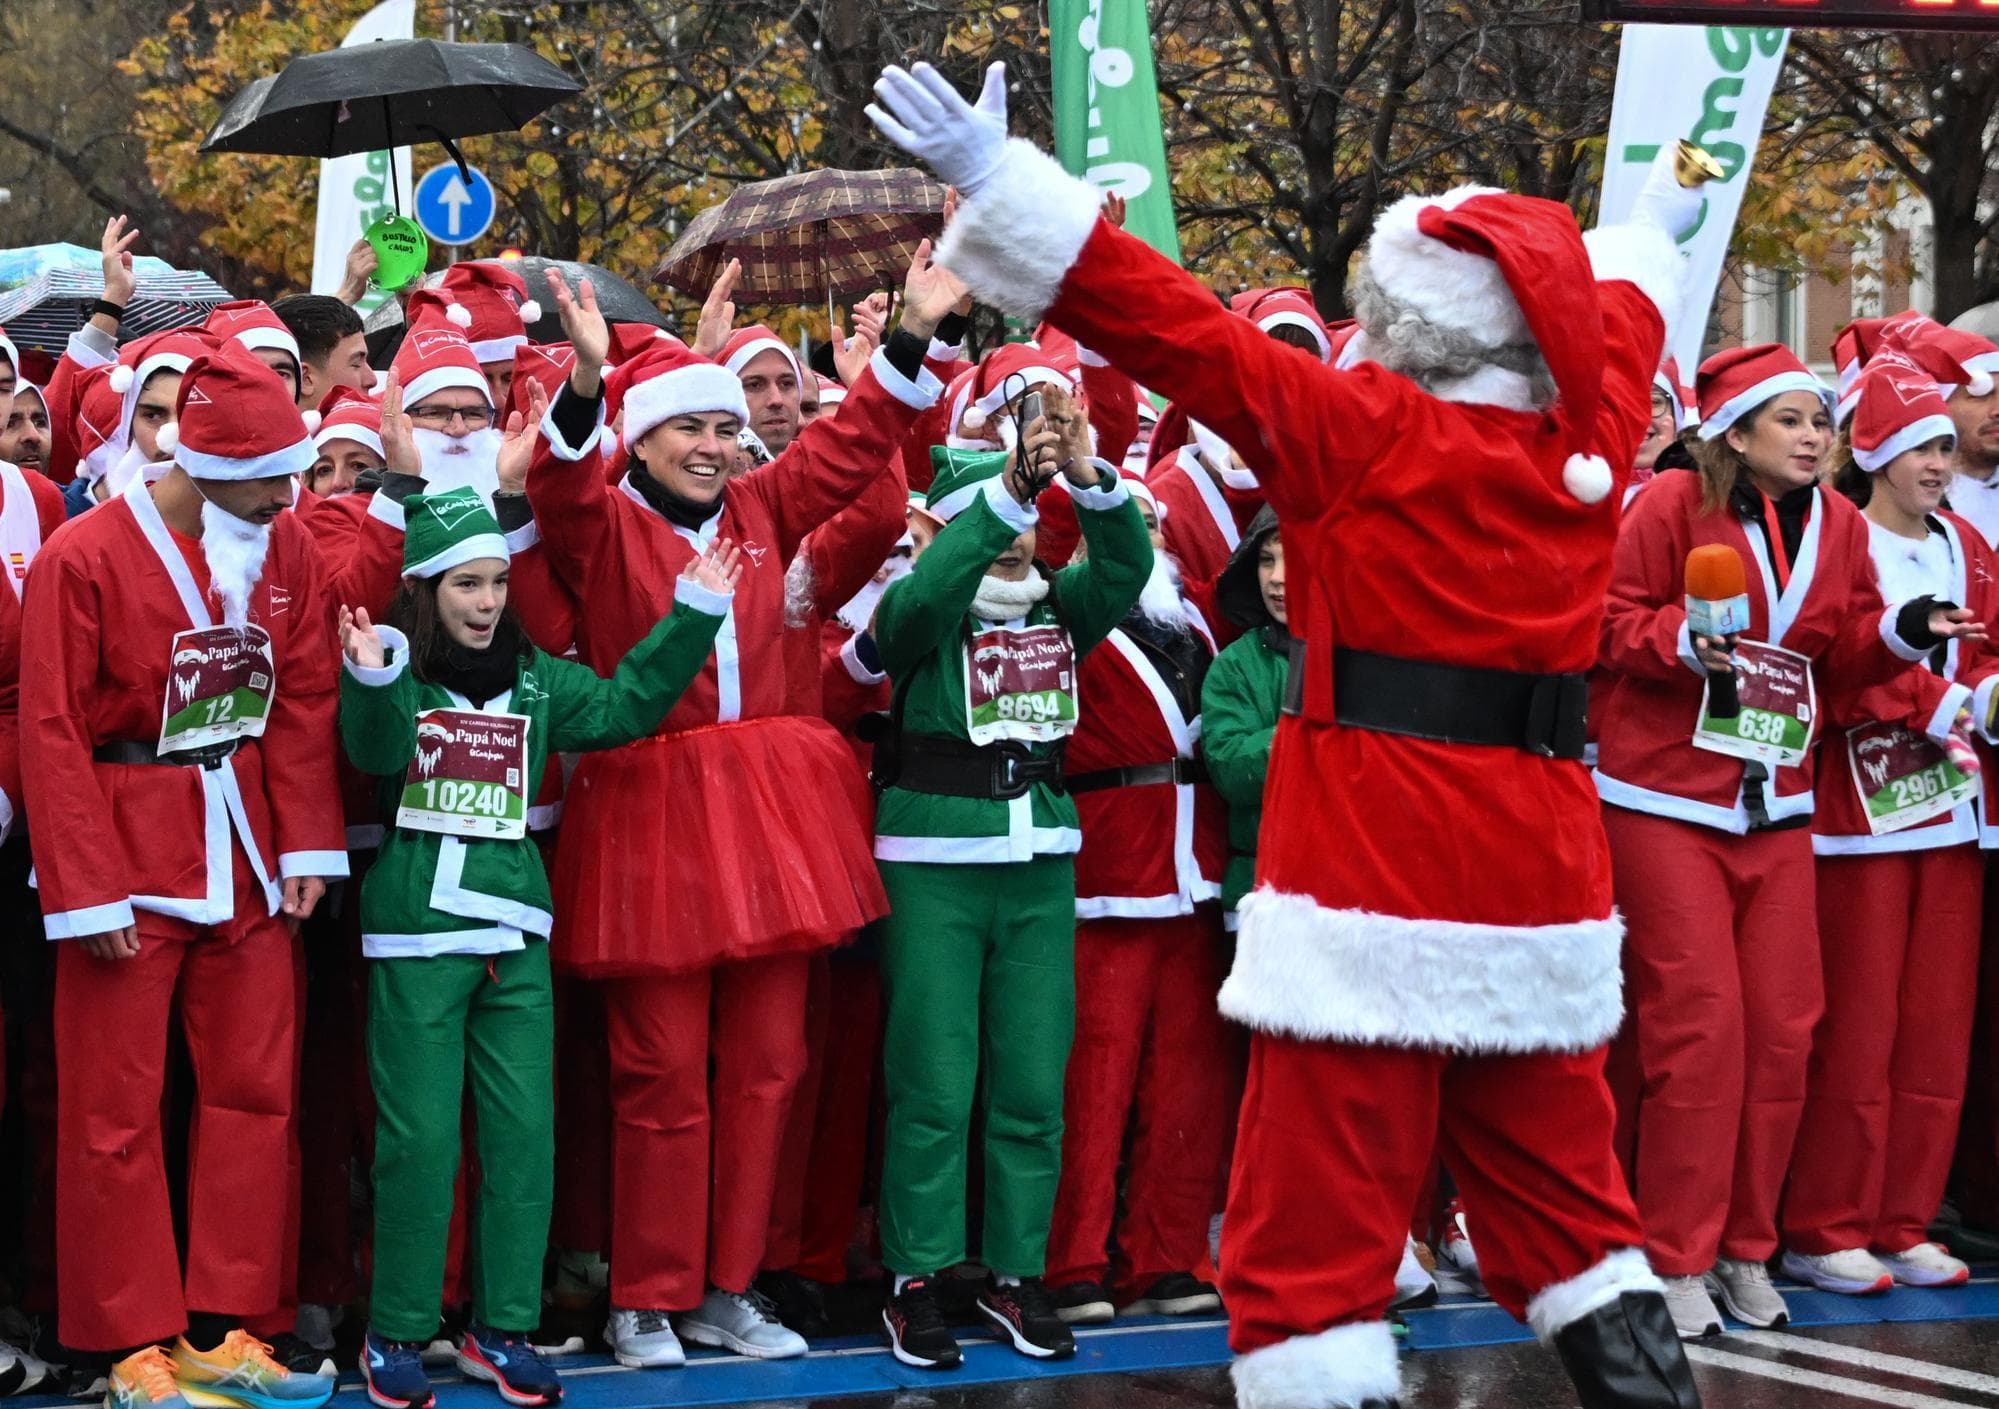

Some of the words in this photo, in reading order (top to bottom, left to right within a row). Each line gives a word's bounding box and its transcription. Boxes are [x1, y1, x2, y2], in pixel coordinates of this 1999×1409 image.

[208, 642, 239, 661] Papá
[1036, 640, 1067, 656] Noel
[205, 695, 235, 725] 12
[997, 692, 1060, 722] 8694
[455, 728, 489, 748] Papá
[492, 731, 517, 748] Noel
[1738, 708, 1786, 745] 638
[422, 779, 508, 817] 10240
[1890, 763, 1948, 808] 2961
